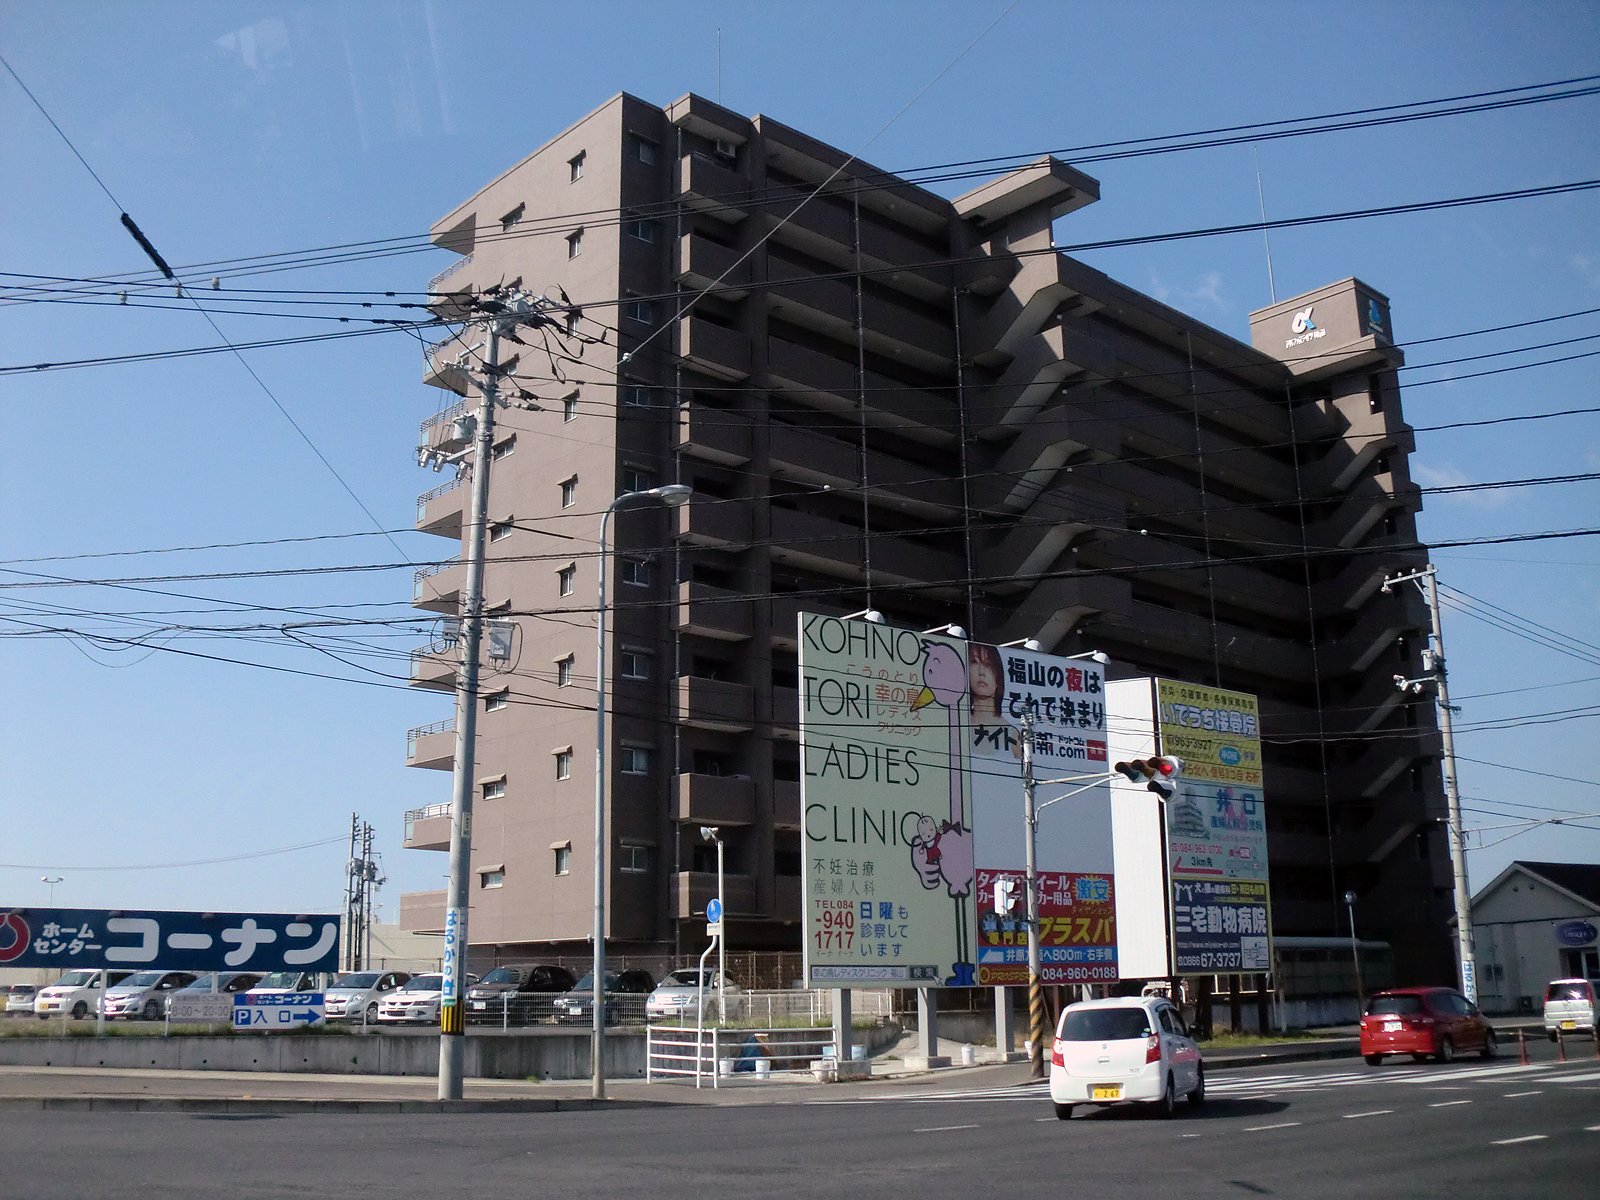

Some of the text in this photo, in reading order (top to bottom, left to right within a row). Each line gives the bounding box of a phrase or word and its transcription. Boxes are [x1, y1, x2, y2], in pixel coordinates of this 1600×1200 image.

[803, 616, 921, 665] KOHNO
[847, 664, 918, 685] こうのとり
[1007, 656, 1101, 694] 福山の夜は
[803, 676, 870, 719] TORI
[1009, 691, 1103, 729] これで決まり
[804, 741, 920, 786] LADIES
[805, 804, 922, 847] CLINIC
[813, 858, 875, 876] 不妊治療
[814, 879, 876, 896] 産婦人科
[860, 901, 908, 919] 日曜も
[1175, 905, 1267, 934] 三宅動物病院
[42, 921, 95, 938] ホーム
[860, 922, 908, 939] 診察して
[33, 937, 102, 955] センター
[104, 917, 337, 966] コーナン
[815, 930, 854, 949] 1717
[860, 943, 902, 957] います
[1042, 966, 1117, 980] 084-960-0188
[275, 994, 312, 1004] コーナン
[254, 1010, 291, 1024] 入口
